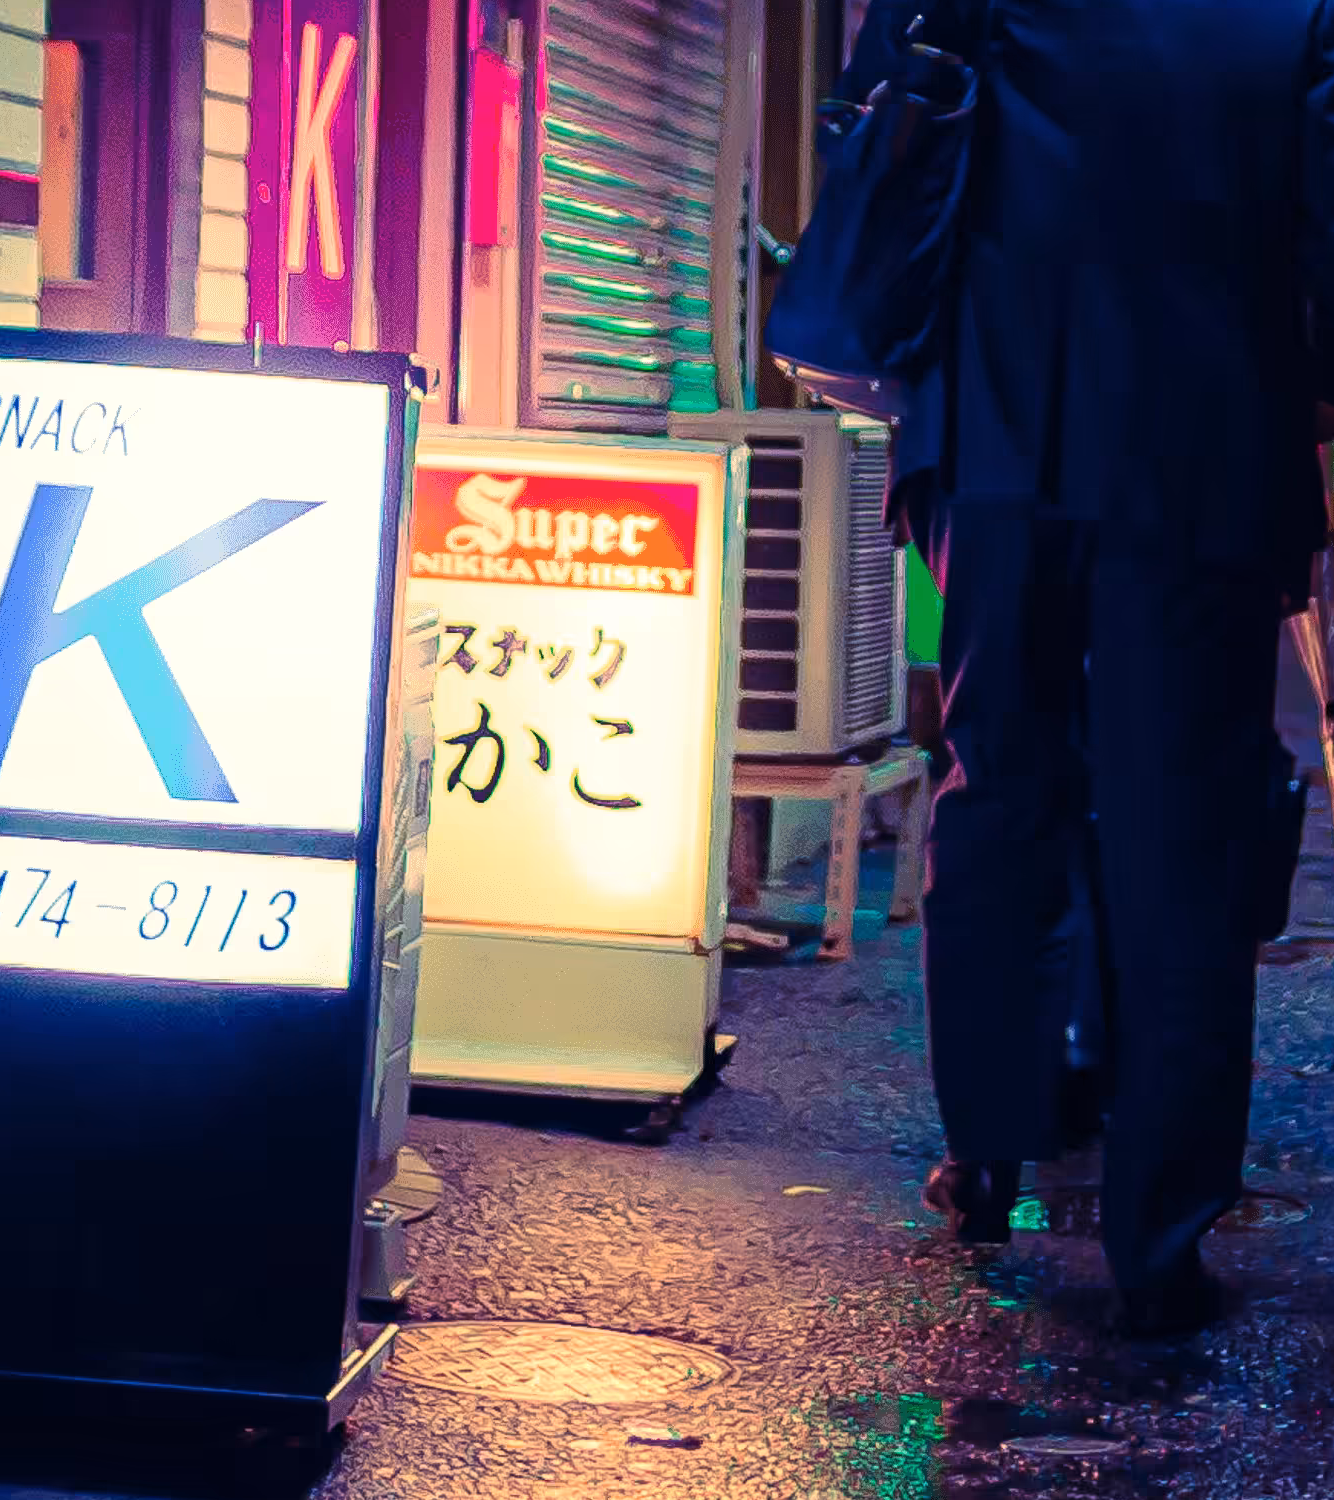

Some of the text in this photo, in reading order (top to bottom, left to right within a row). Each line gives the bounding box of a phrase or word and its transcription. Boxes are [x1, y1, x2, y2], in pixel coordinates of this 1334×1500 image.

[285, 20, 358, 283] K
[445, 475, 660, 558] Super
[443, 625, 624, 688] スナック
[444, 701, 642, 809] かこ
